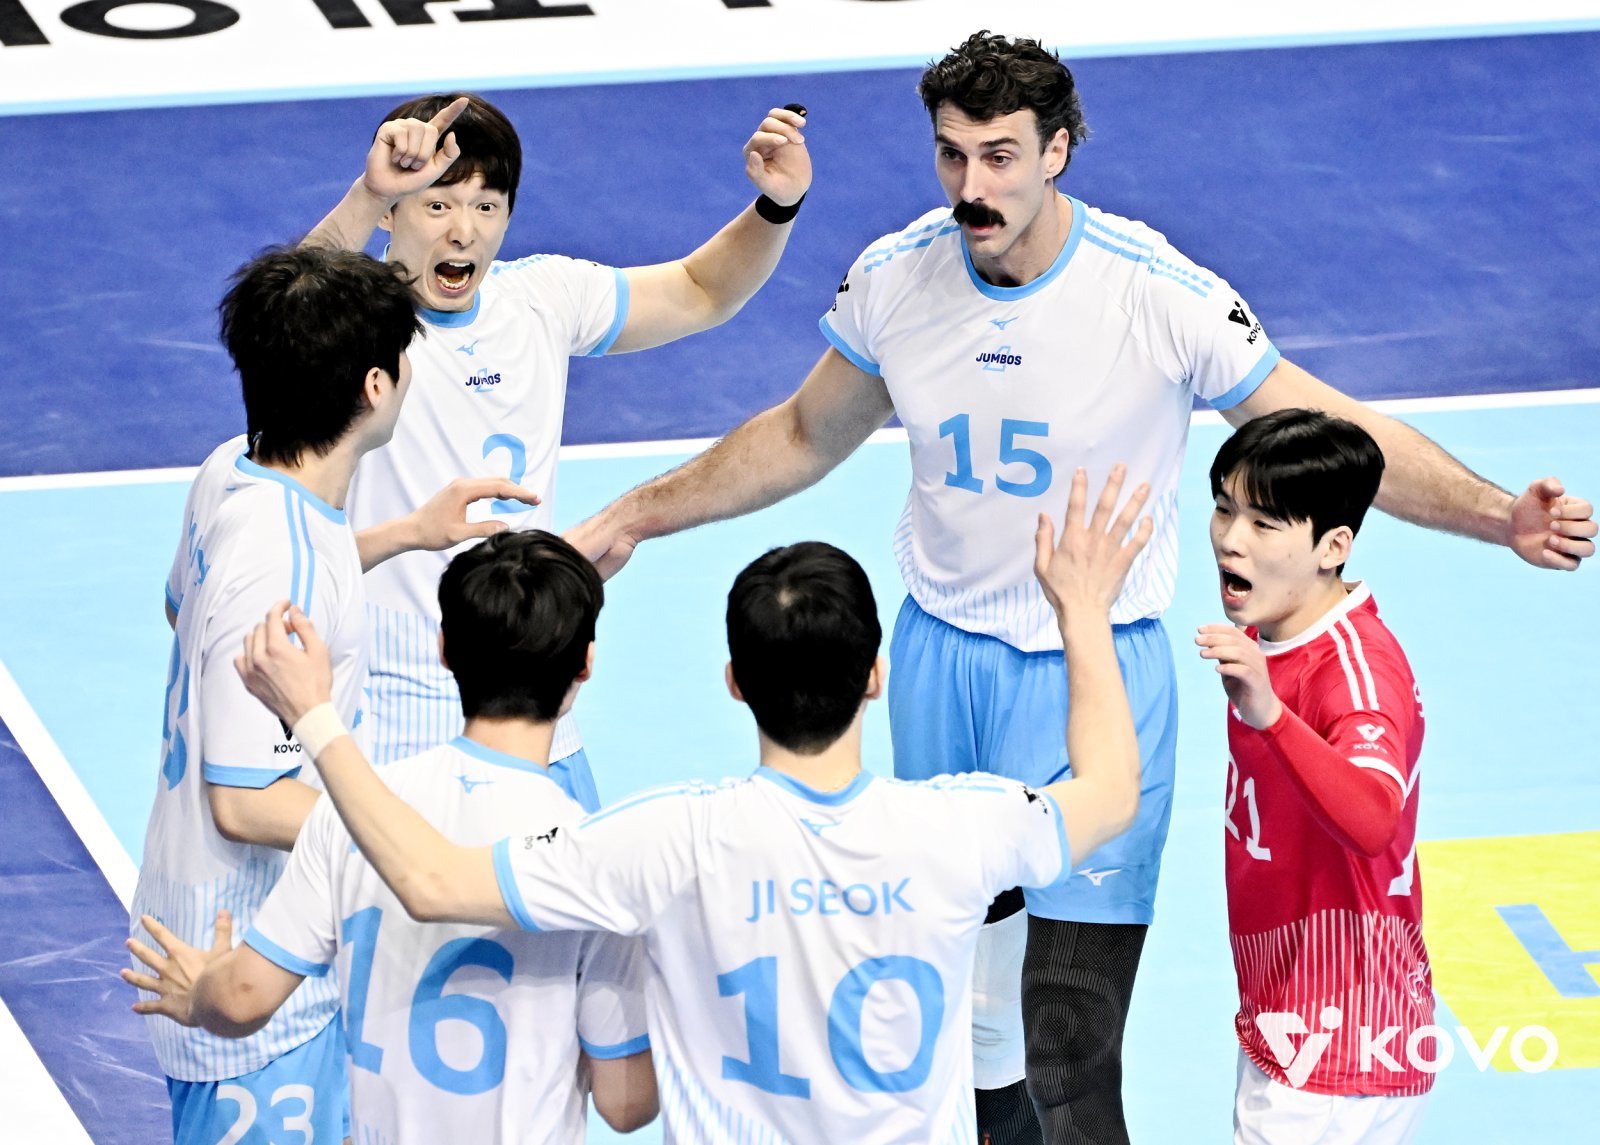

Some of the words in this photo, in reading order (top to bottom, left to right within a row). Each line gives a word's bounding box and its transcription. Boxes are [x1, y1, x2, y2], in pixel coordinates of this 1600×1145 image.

[465, 373, 501, 386] JUOS
[975, 352, 1022, 366] JUMBOS
[482, 433, 538, 515] 2
[938, 413, 1053, 498] 15
[273, 743, 302, 754] KOVO
[745, 880, 775, 923] JI
[790, 877, 916, 917] SEOK
[341, 905, 515, 1097] 16
[717, 955, 945, 1100] 10
[216, 1084, 315, 1145] 23
